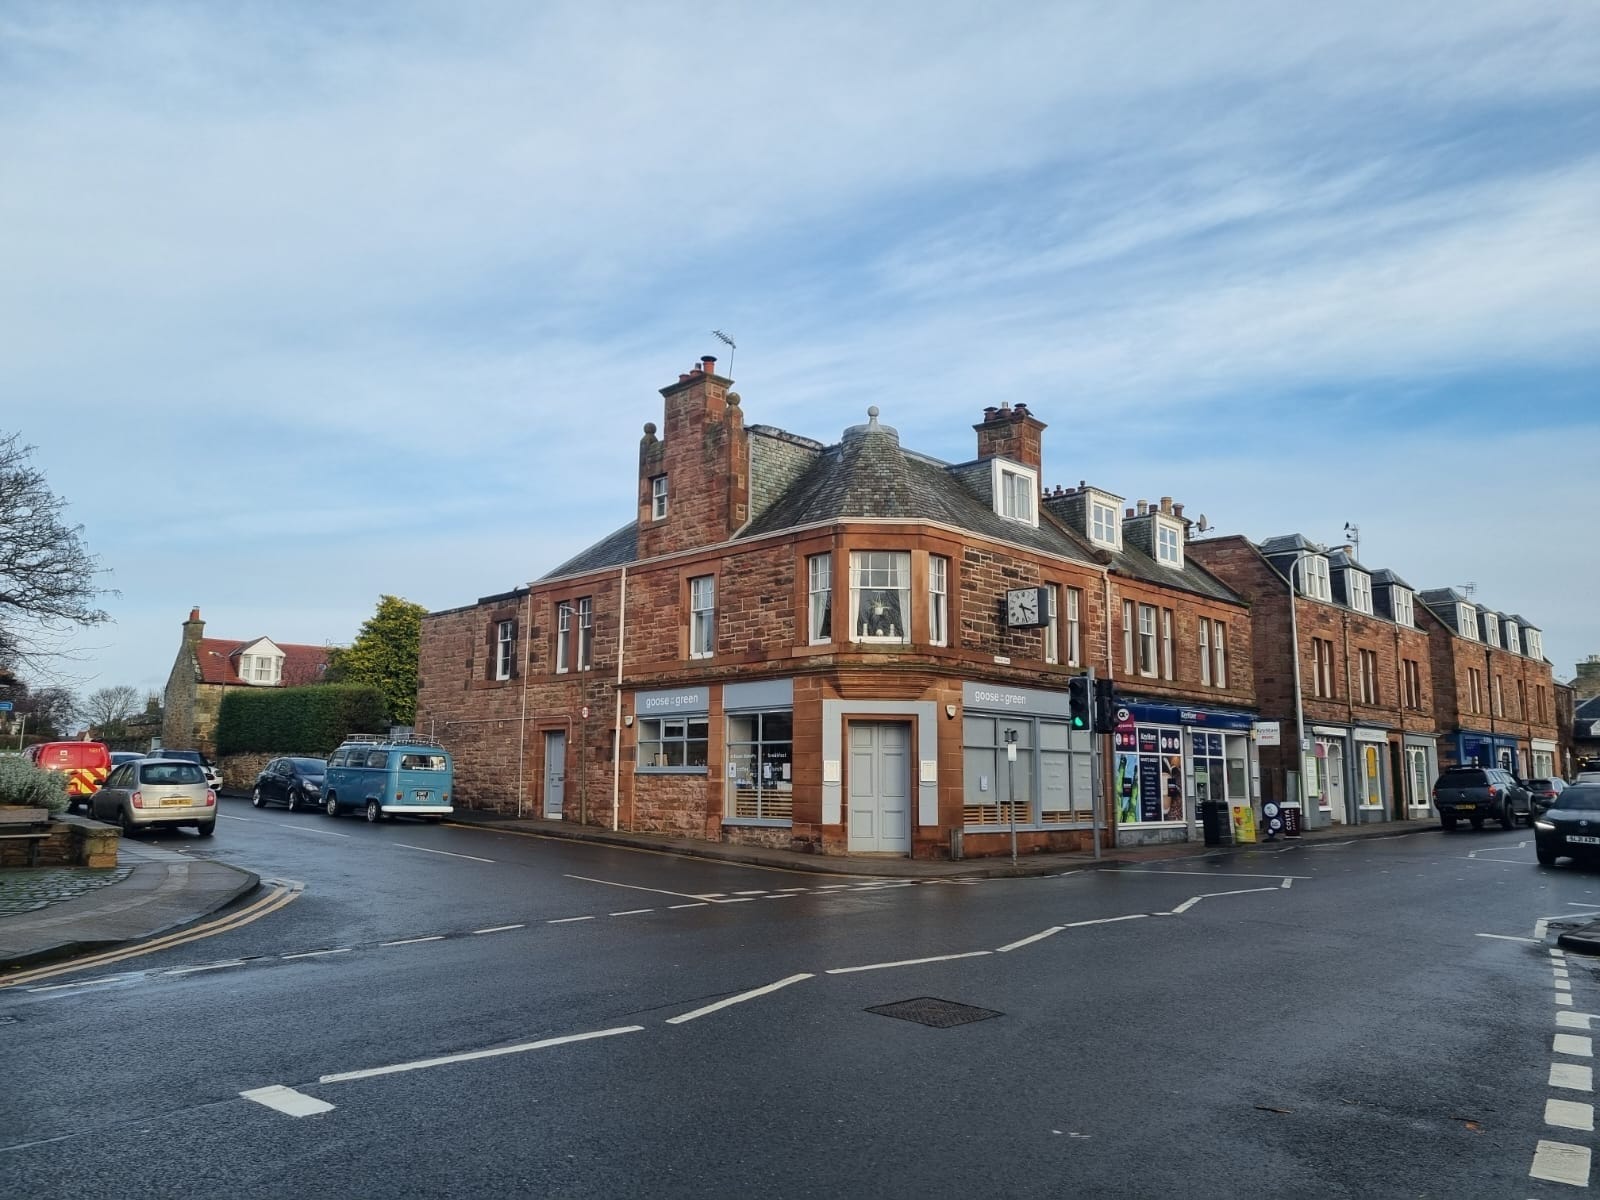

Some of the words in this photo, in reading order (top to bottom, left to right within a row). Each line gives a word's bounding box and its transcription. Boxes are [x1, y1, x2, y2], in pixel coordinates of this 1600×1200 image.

[646, 697, 669, 708] goose
[675, 694, 698, 706] green
[975, 691, 999, 702] goose
[1005, 694, 1026, 705] green
